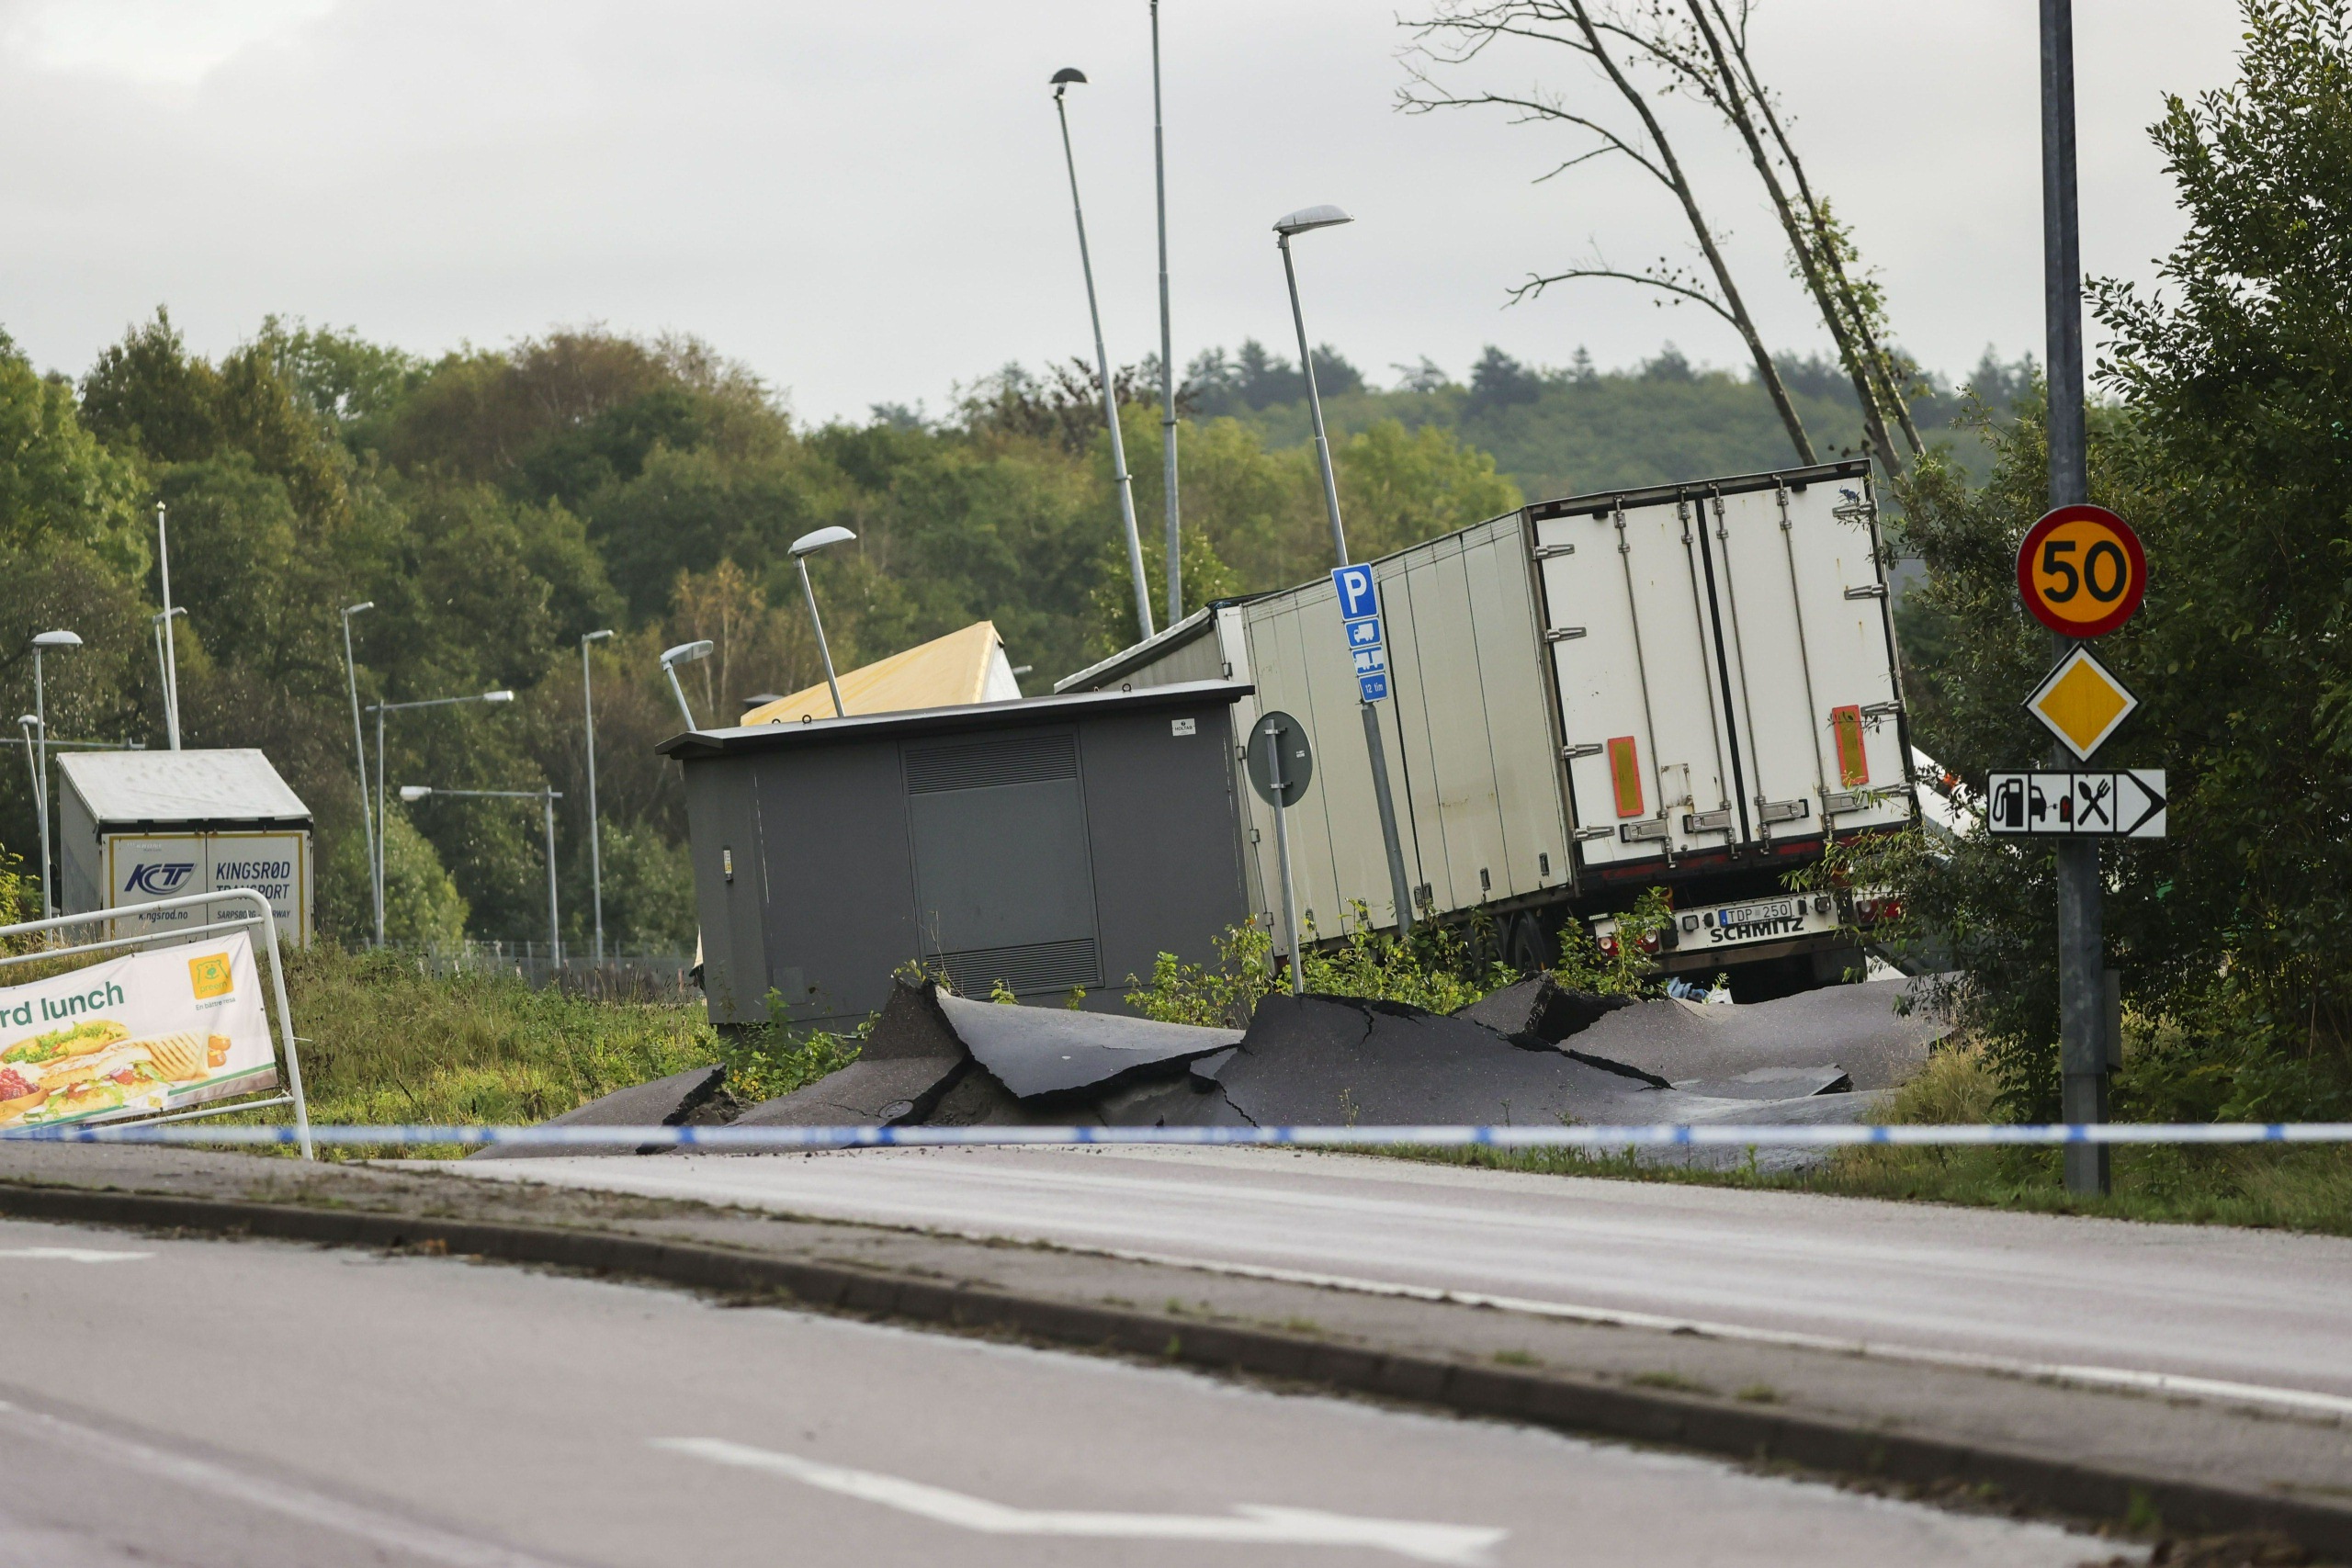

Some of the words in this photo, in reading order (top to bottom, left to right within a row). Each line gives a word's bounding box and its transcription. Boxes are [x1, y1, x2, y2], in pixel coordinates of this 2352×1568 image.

[2041, 539, 2127, 603] 50
[1343, 570, 1367, 615] P
[1365, 683, 1373, 694] 12
[1374, 682, 1384, 692] tim
[216, 861, 290, 880] KINGSRØD
[1728, 908, 1752, 922] TDP
[1763, 904, 1788, 918] 250
[1710, 917, 1804, 943] SCHMITZ
[199, 980, 228, 994] preem
[40, 981, 125, 1021] lunch
[204, 999, 223, 1010] bättre
